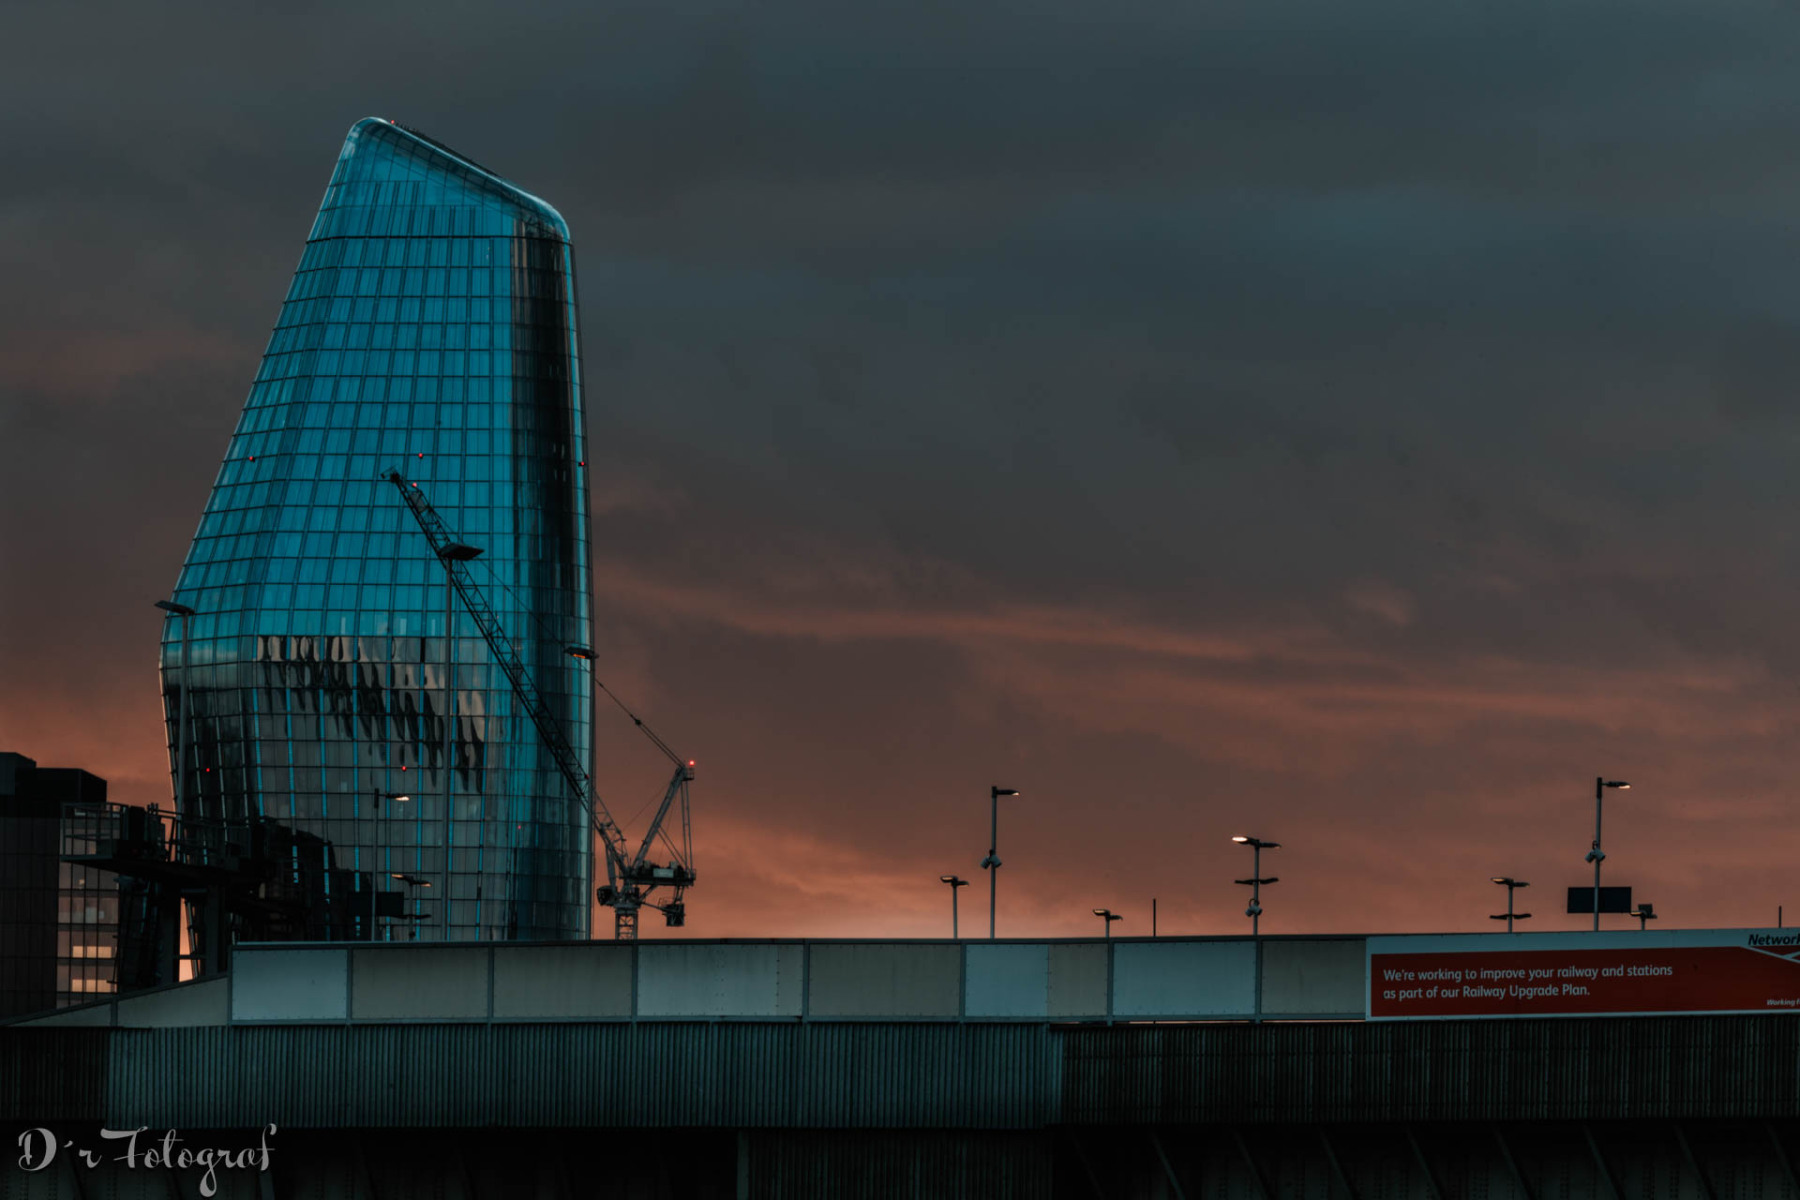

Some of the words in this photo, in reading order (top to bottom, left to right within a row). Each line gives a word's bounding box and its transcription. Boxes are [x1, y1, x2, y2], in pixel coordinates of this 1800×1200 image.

[1383, 968, 1415, 981] We're
[1418, 968, 1462, 983] working
[1465, 968, 1477, 979] to
[1480, 967, 1525, 982] improve
[1528, 968, 1554, 982] your
[1557, 965, 1598, 980] railway
[1602, 965, 1624, 977] and
[1627, 964, 1673, 977] stations
[1383, 990, 1396, 999] as
[1399, 987, 1423, 1001] part
[1426, 986, 1438, 998] of
[1441, 988, 1460, 998] our
[1463, 985, 1506, 1000] Railway
[1509, 984, 1559, 999] Upgrade
[1562, 983, 1590, 996] Plan.
[1766, 998, 1795, 1006] Working
